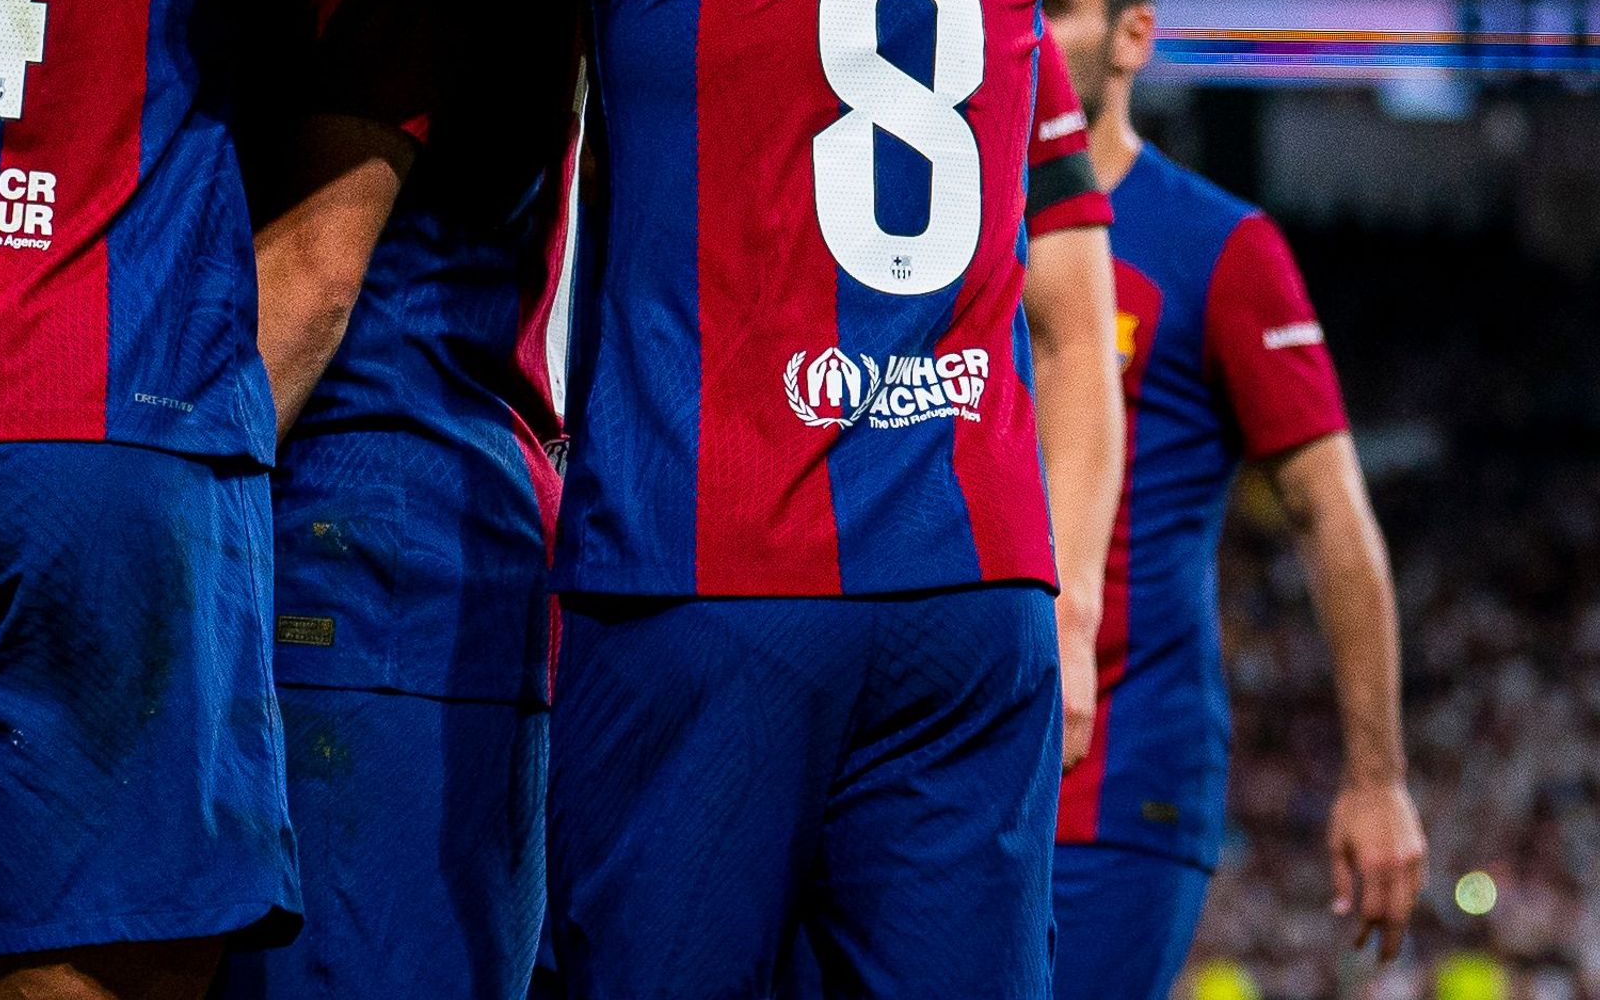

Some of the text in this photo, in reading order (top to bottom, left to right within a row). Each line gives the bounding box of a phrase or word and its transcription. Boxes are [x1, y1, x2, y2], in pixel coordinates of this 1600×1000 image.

[3, 234, 52, 251] Agency
[885, 348, 989, 386] UNHCR
[869, 376, 985, 416] ACNUR
[869, 416, 889, 430] The
[889, 413, 910, 429] UN
[909, 406, 960, 425] Refugee
